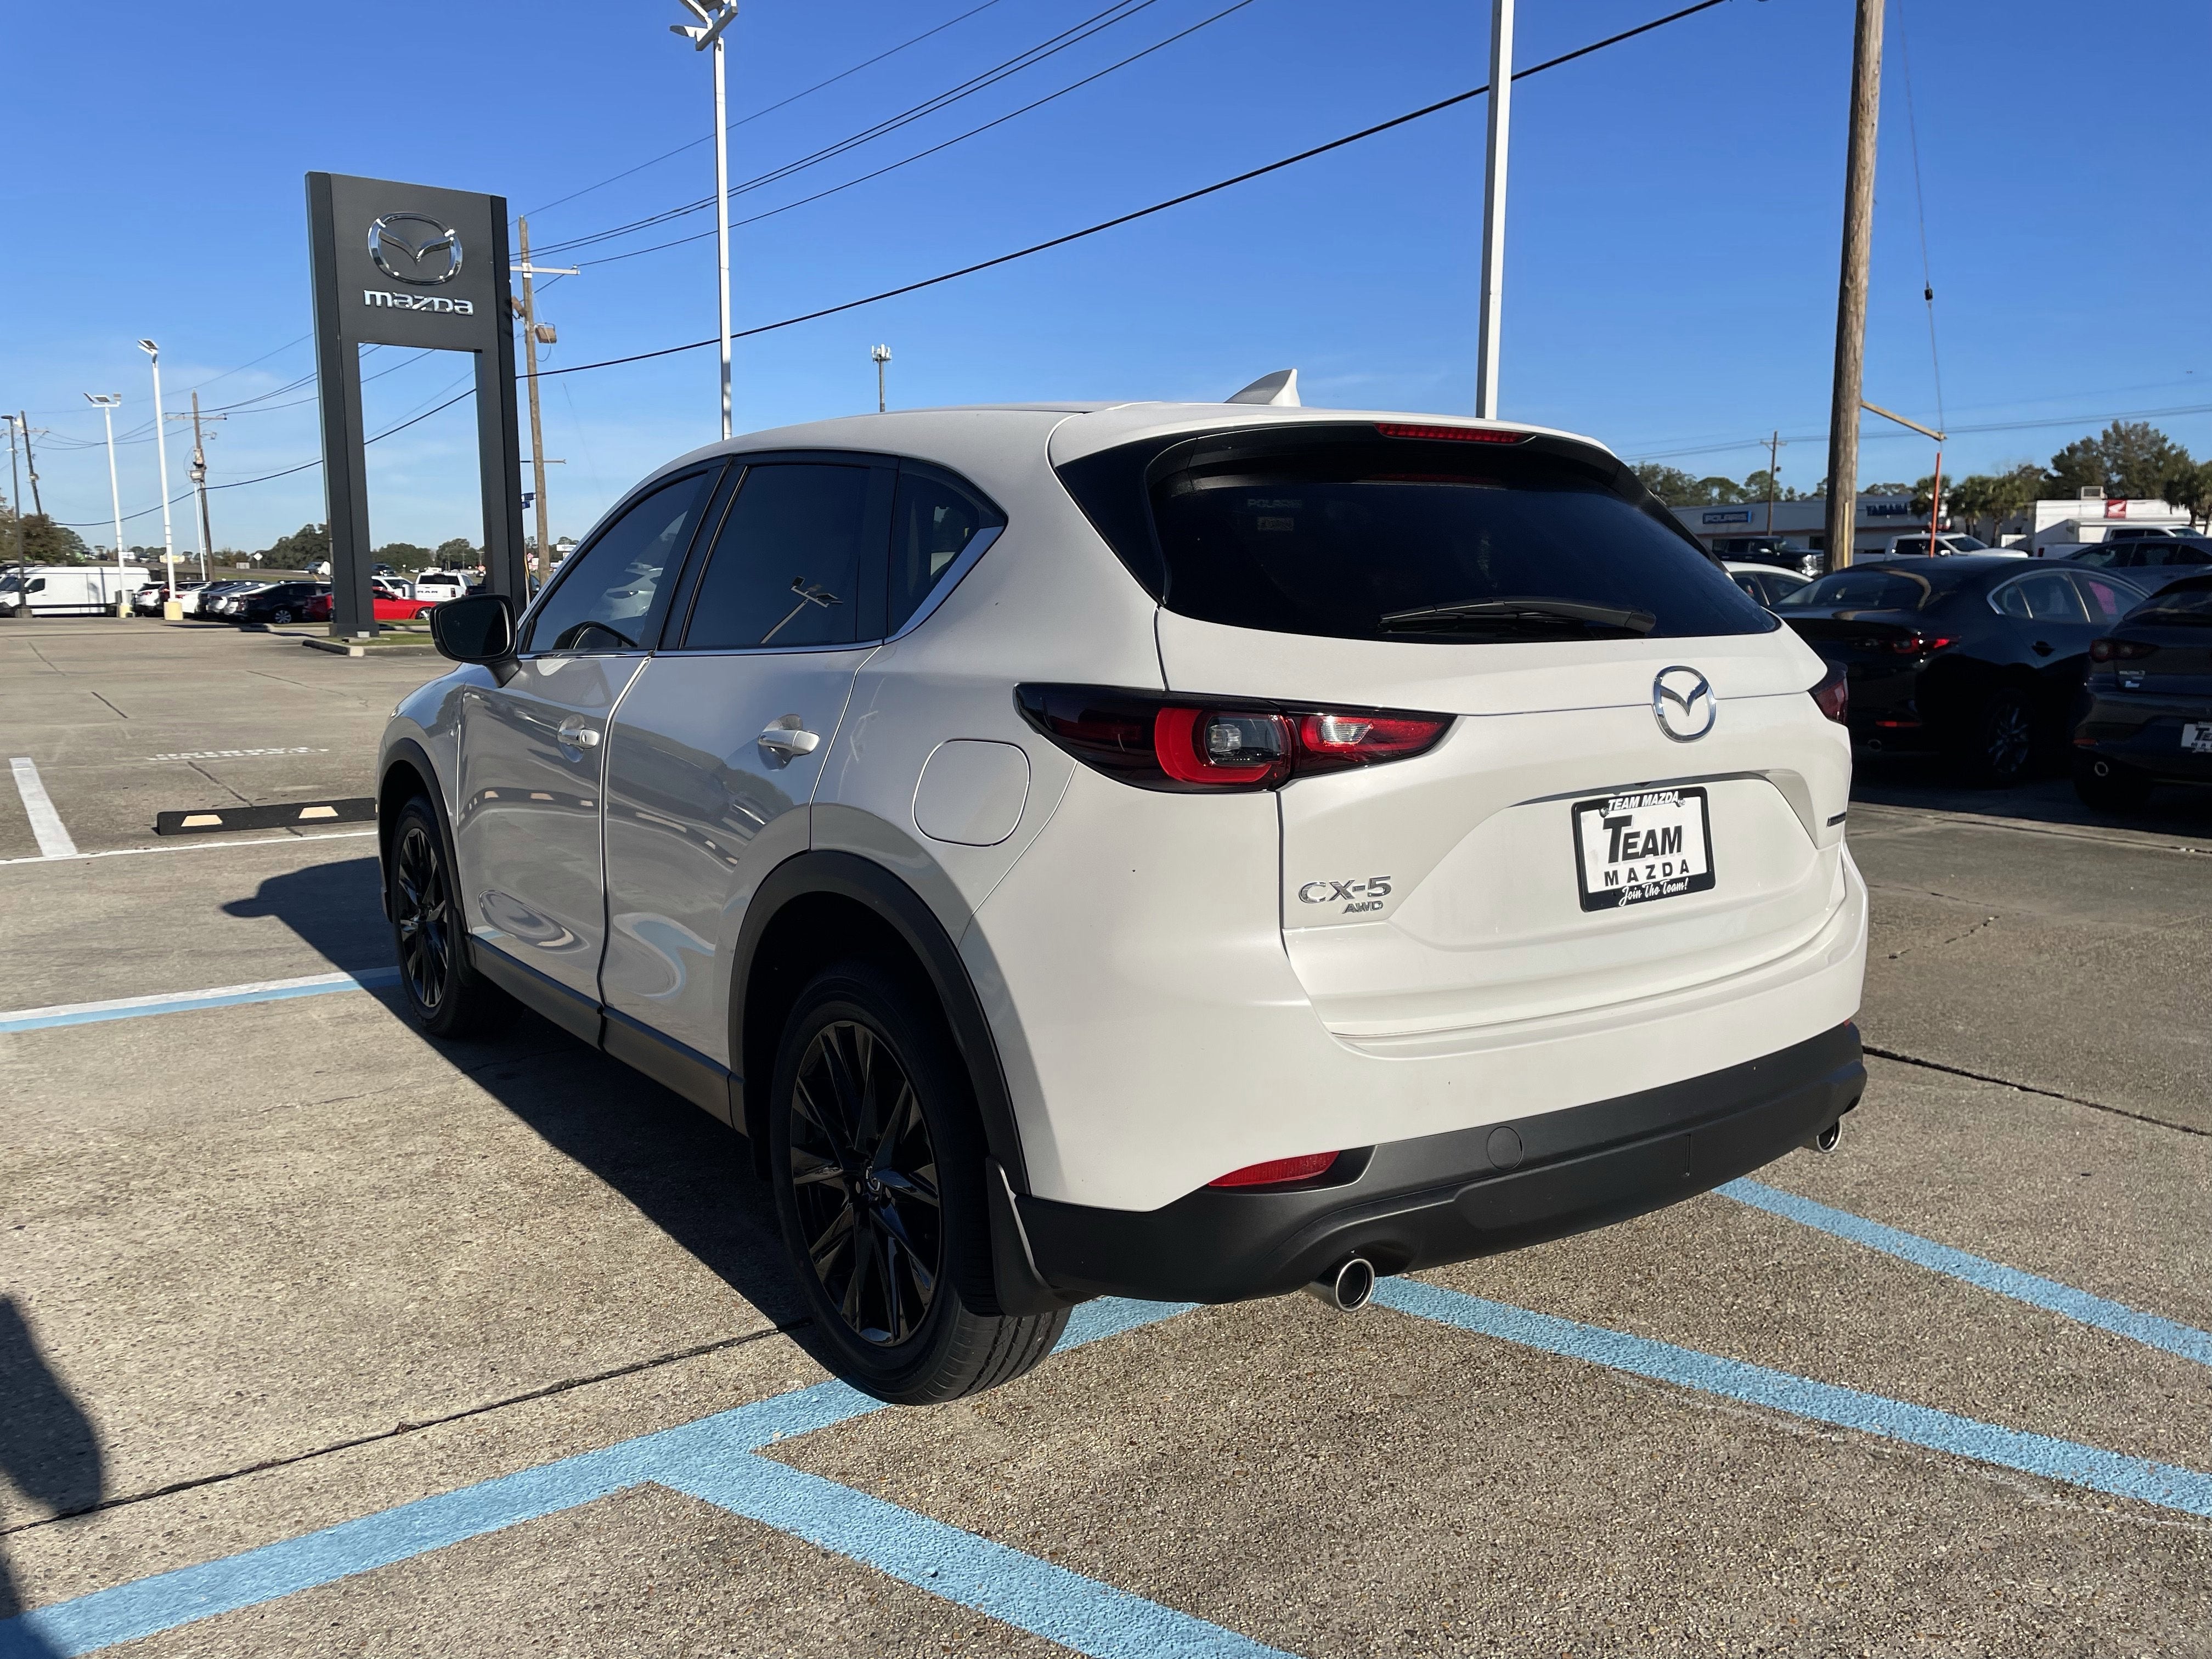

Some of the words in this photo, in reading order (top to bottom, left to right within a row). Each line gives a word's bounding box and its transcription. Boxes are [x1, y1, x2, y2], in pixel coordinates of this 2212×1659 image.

[1609, 796, 1640, 811] TEAM
[1641, 791, 1679, 807] MAZDA
[1603, 815, 1683, 864] TEAM
[1604, 859, 1690, 887] MAZDA
[1299, 876, 1392, 904] CX-5
[1618, 886, 1642, 906] Join
[1641, 882, 1661, 898] The
[1660, 878, 1689, 895] Team!
[1342, 900, 1384, 914] AWD
